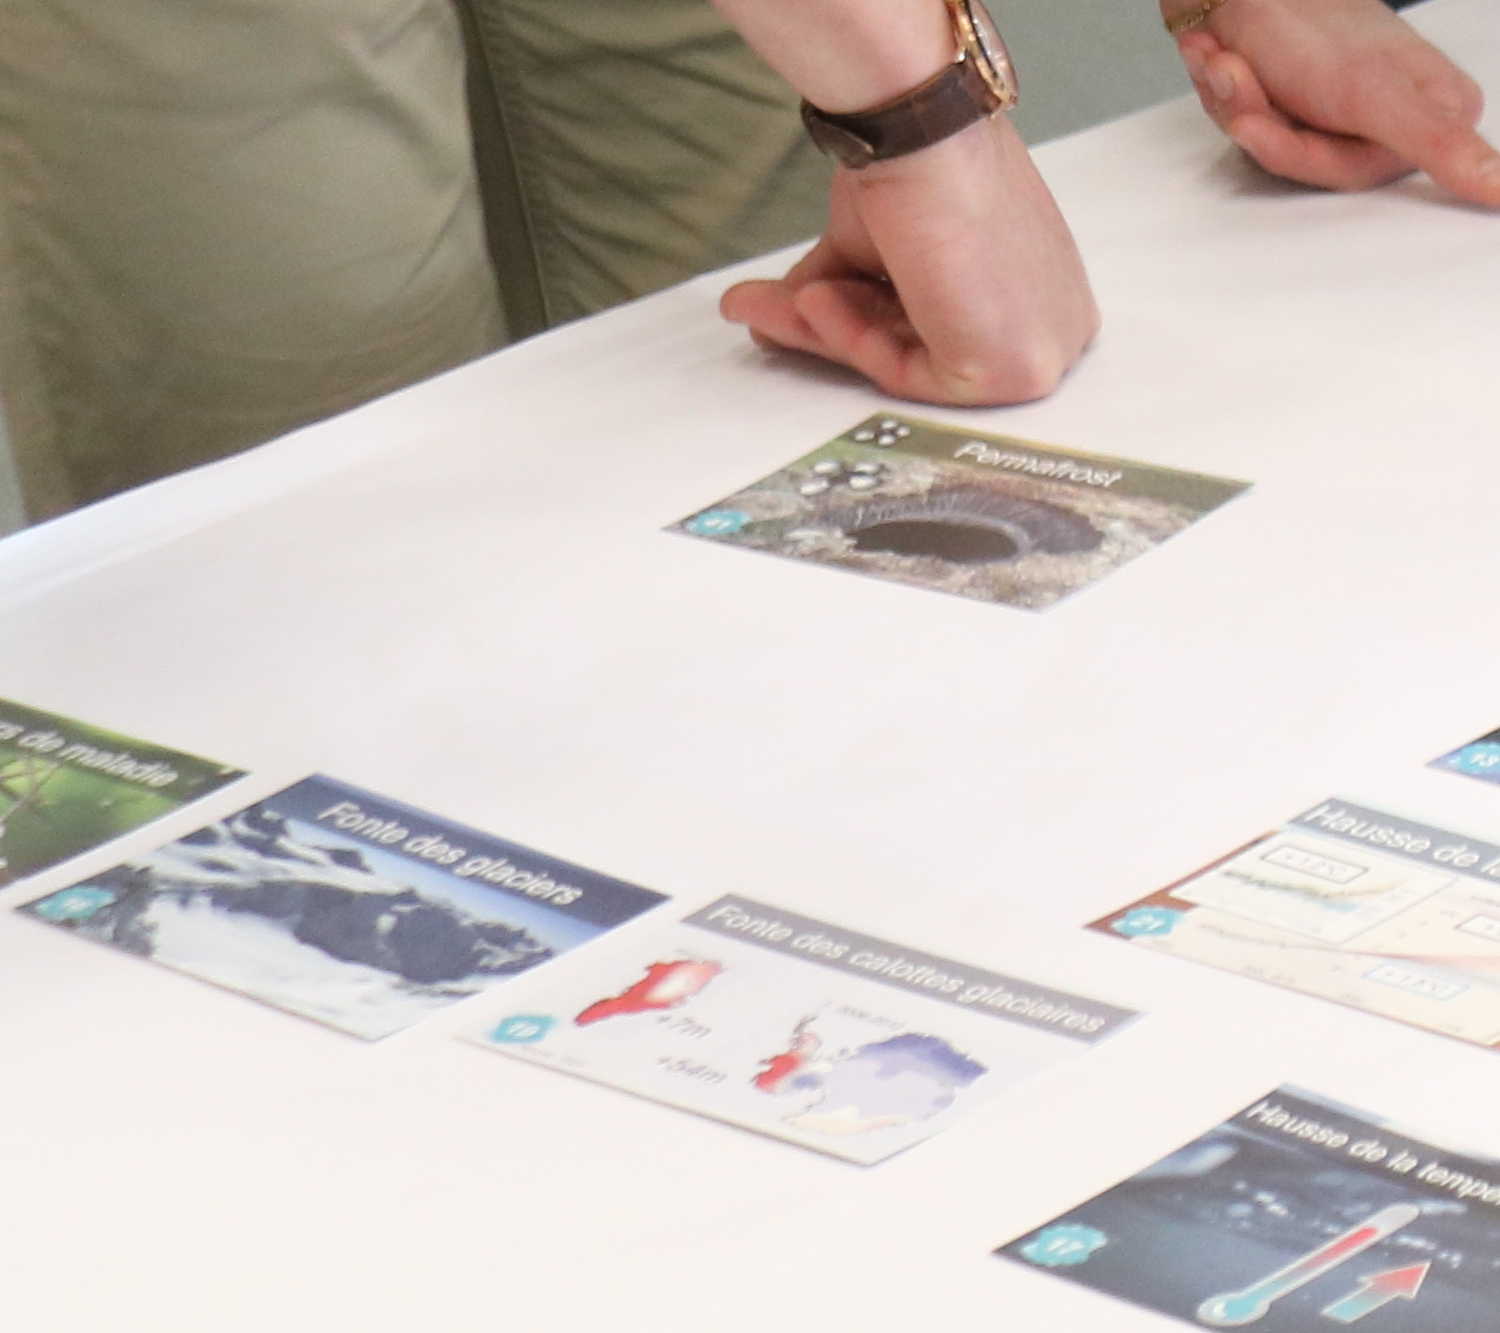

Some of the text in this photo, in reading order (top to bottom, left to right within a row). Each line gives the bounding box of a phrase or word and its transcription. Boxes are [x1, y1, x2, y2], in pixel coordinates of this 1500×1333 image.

[954, 440, 1124, 488] Permafrost
[318, 800, 583, 908] Fonte des glaciers
[1303, 805, 1432, 857] Hausse
[1433, 838, 1482, 870] de
[704, 904, 795, 945] Fonte
[792, 927, 845, 961] des
[849, 944, 962, 995] calottes
[958, 975, 1107, 1035] glaciaires
[1246, 1099, 1350, 1151] Hausse
[1349, 1137, 1390, 1164] de
[1387, 1147, 1419, 1176] la
